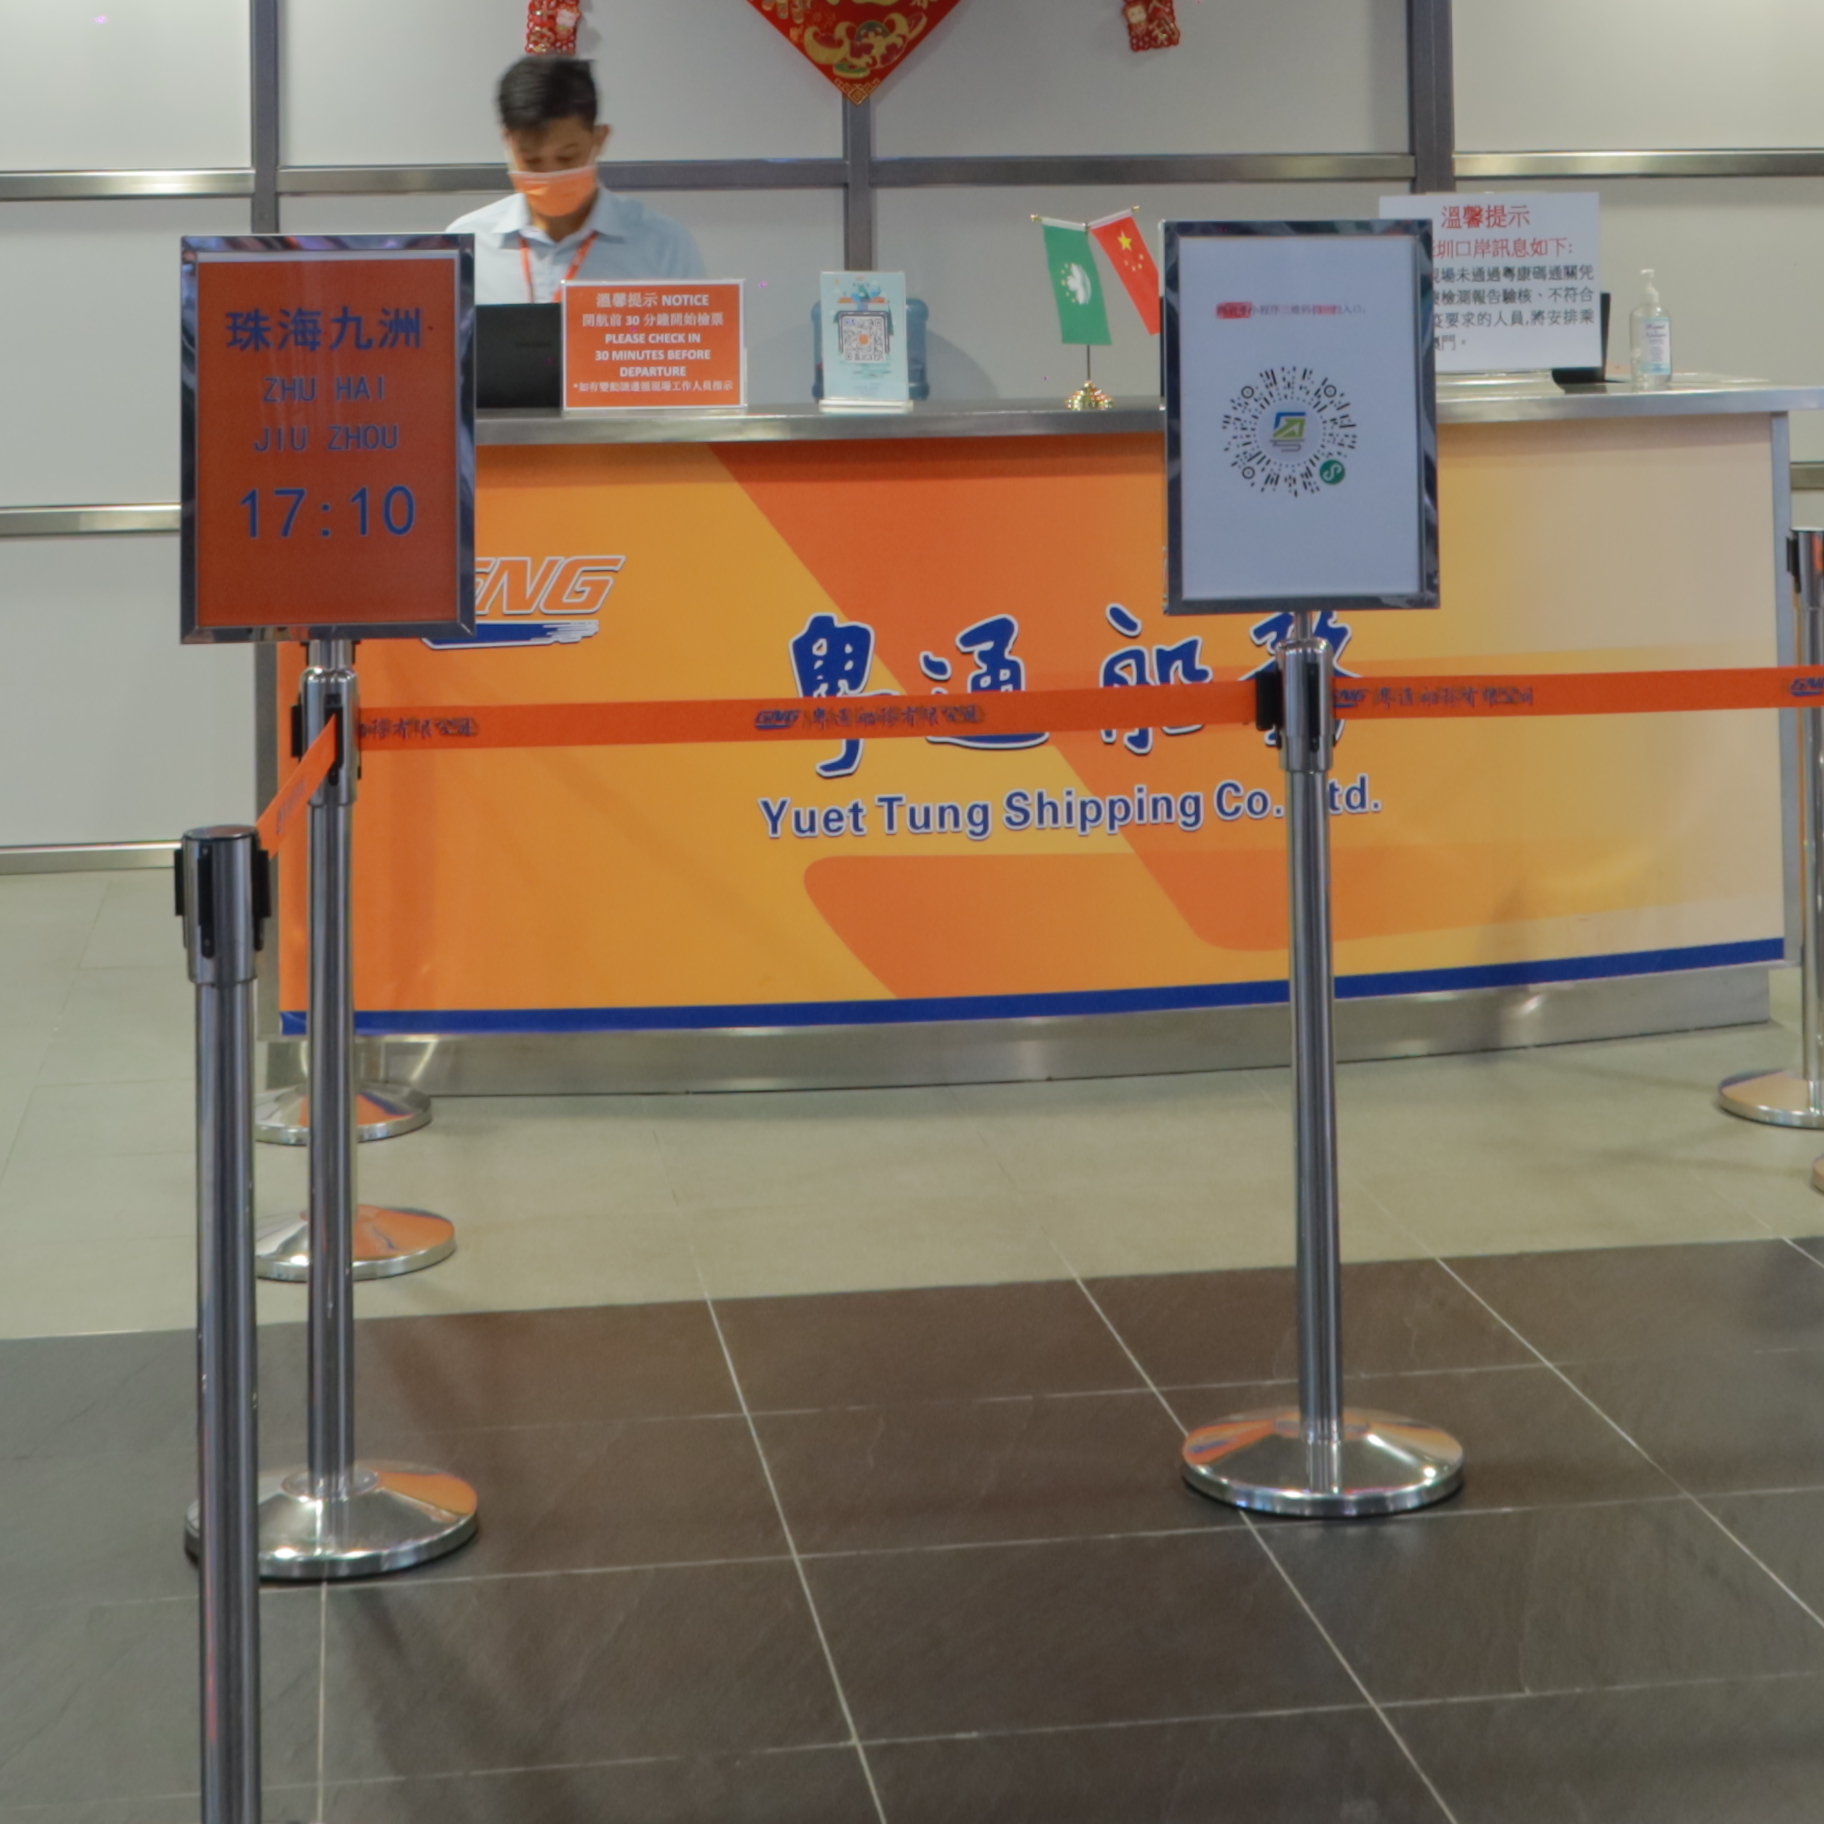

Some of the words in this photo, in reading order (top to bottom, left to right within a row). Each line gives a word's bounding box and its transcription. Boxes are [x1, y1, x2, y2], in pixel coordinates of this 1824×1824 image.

[1440, 204, 1531, 230] 溫馨提示
[661, 293, 710, 307] NOTICE
[225, 306, 423, 352] 珠海九洲
[626, 315, 640, 326] 30
[604, 333, 646, 344] PLEASE
[648, 333, 686, 344] CHECK
[688, 333, 701, 344] IN
[595, 350, 610, 361] 30
[611, 349, 665, 361] MINUTES
[667, 349, 711, 360] BEFORE
[619, 366, 687, 377] DEPARTURE
[262, 377, 317, 403] ZHU
[336, 375, 385, 401] HAI
[254, 426, 308, 453] JIU
[327, 425, 400, 451] ZHOU
[240, 485, 416, 539] 17:10
[475, 555, 626, 616] NG
[758, 798, 866, 838] Yuet
[877, 794, 992, 840] Tung
[1002, 784, 1204, 835] Shipping
[1327, 774, 1382, 816] td.
